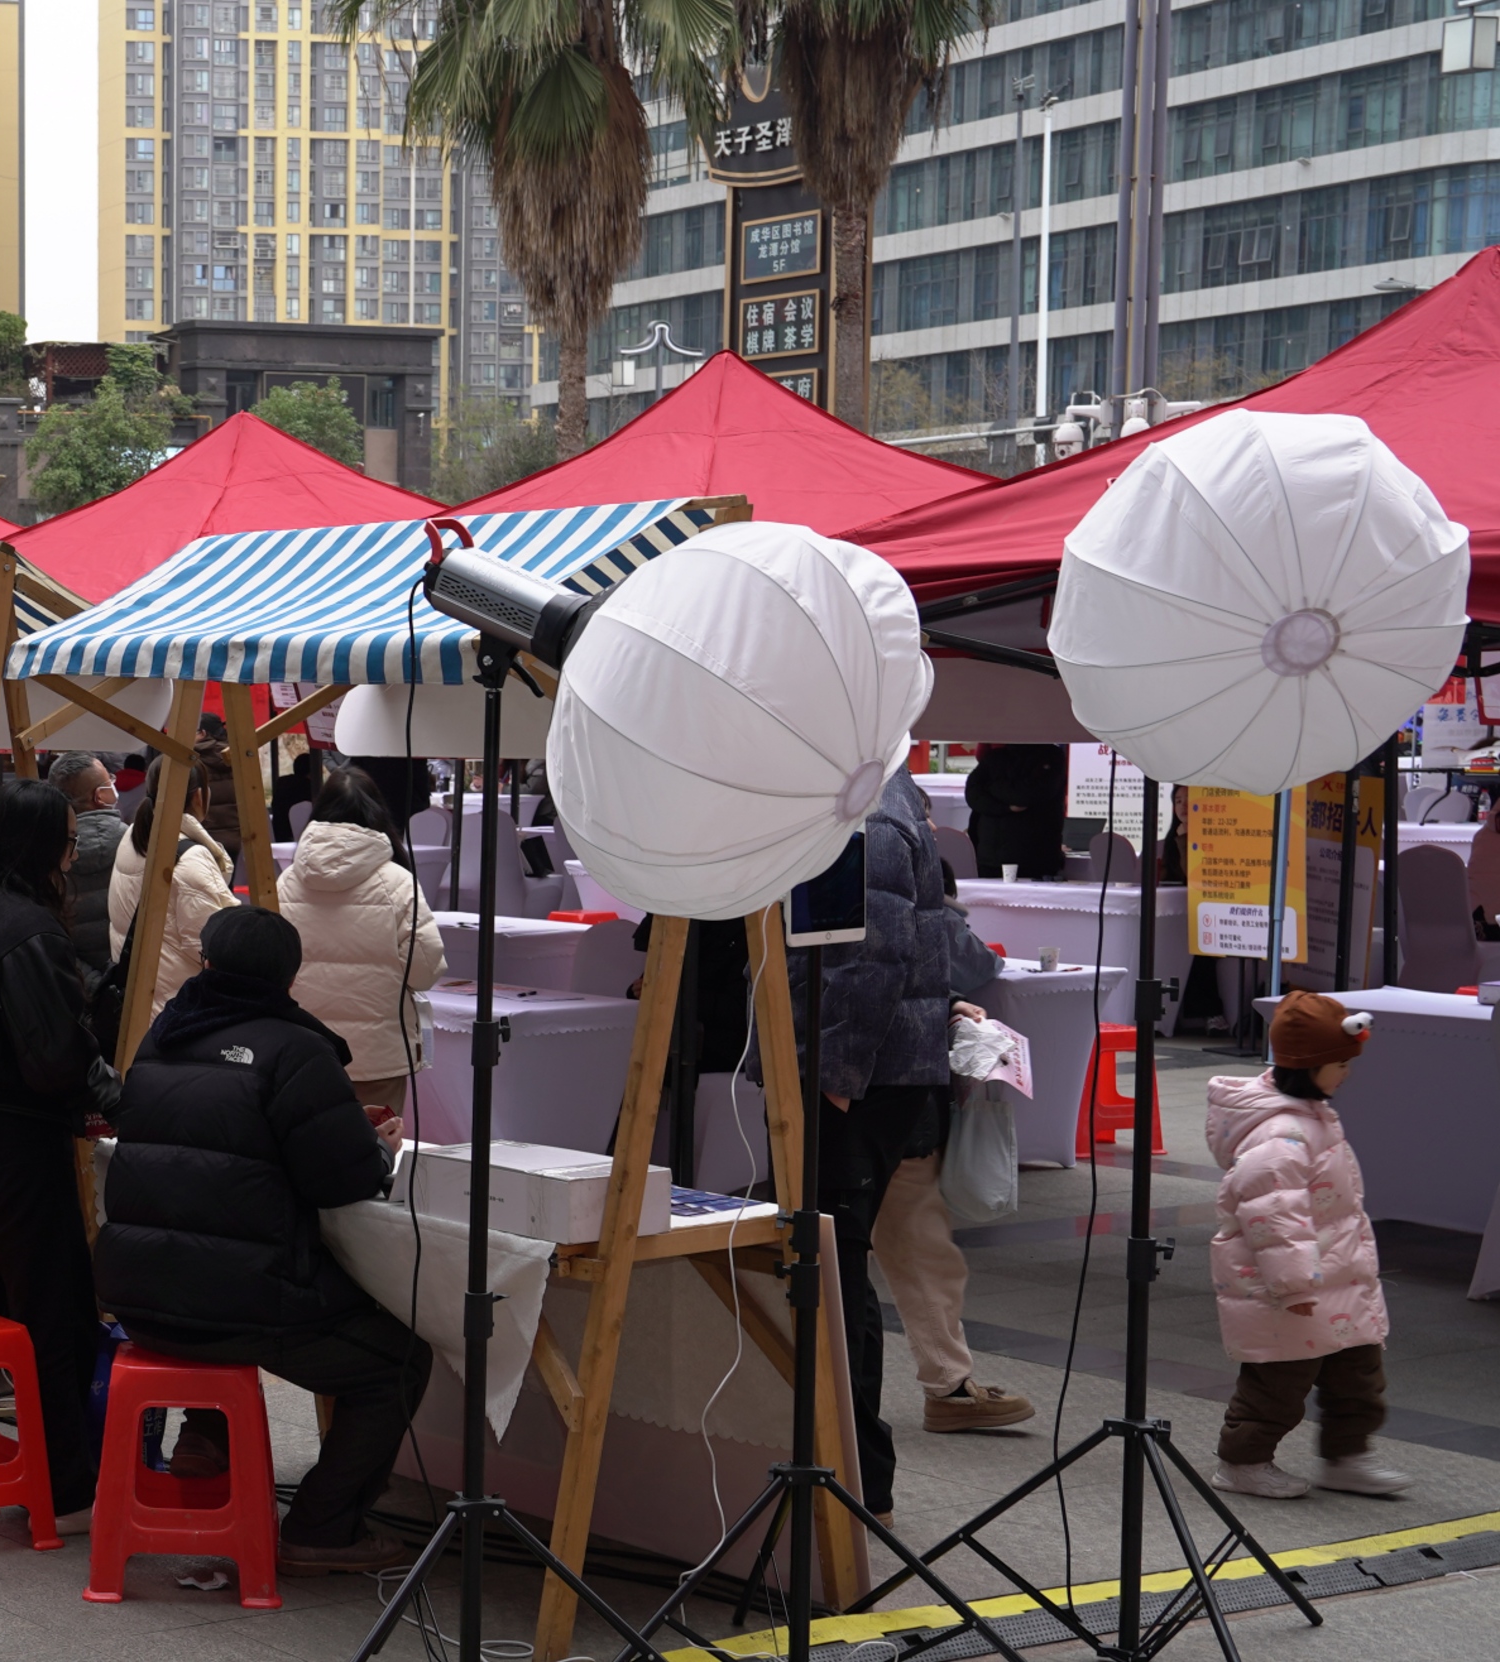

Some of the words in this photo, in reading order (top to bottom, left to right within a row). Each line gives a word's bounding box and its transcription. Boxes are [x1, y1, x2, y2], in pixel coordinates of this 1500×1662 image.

[750, 219, 814, 243] 成华区图书馆
[758, 239, 800, 259] 龙潭分馆
[772, 258, 786, 272] 5F
[746, 302, 775, 328] 住宿
[784, 297, 813, 322] 会议
[746, 328, 775, 354] 棋牌
